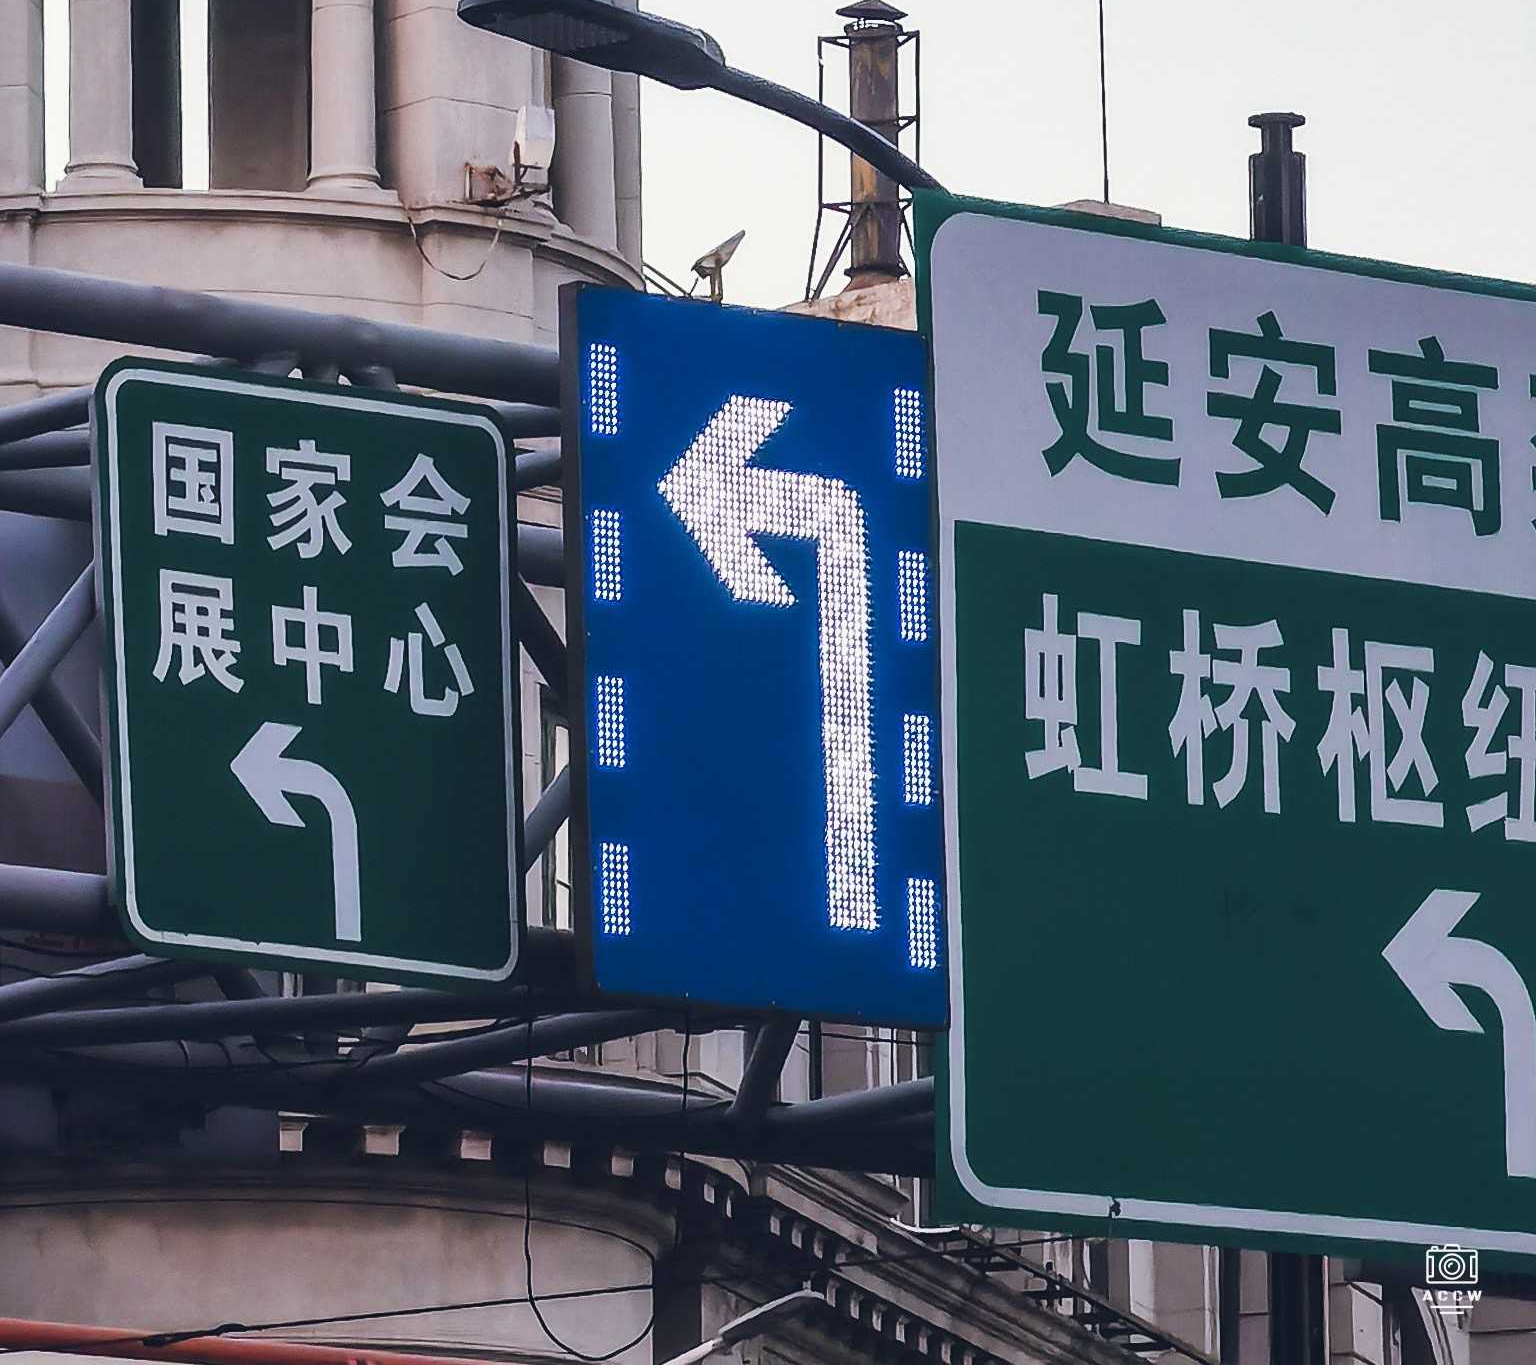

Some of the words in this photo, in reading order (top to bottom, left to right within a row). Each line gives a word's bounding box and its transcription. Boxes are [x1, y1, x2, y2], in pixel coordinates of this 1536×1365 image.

[1037, 290, 1536, 536] 延安高
[152, 421, 471, 575] 国家会
[152, 569, 474, 717] 展中心
